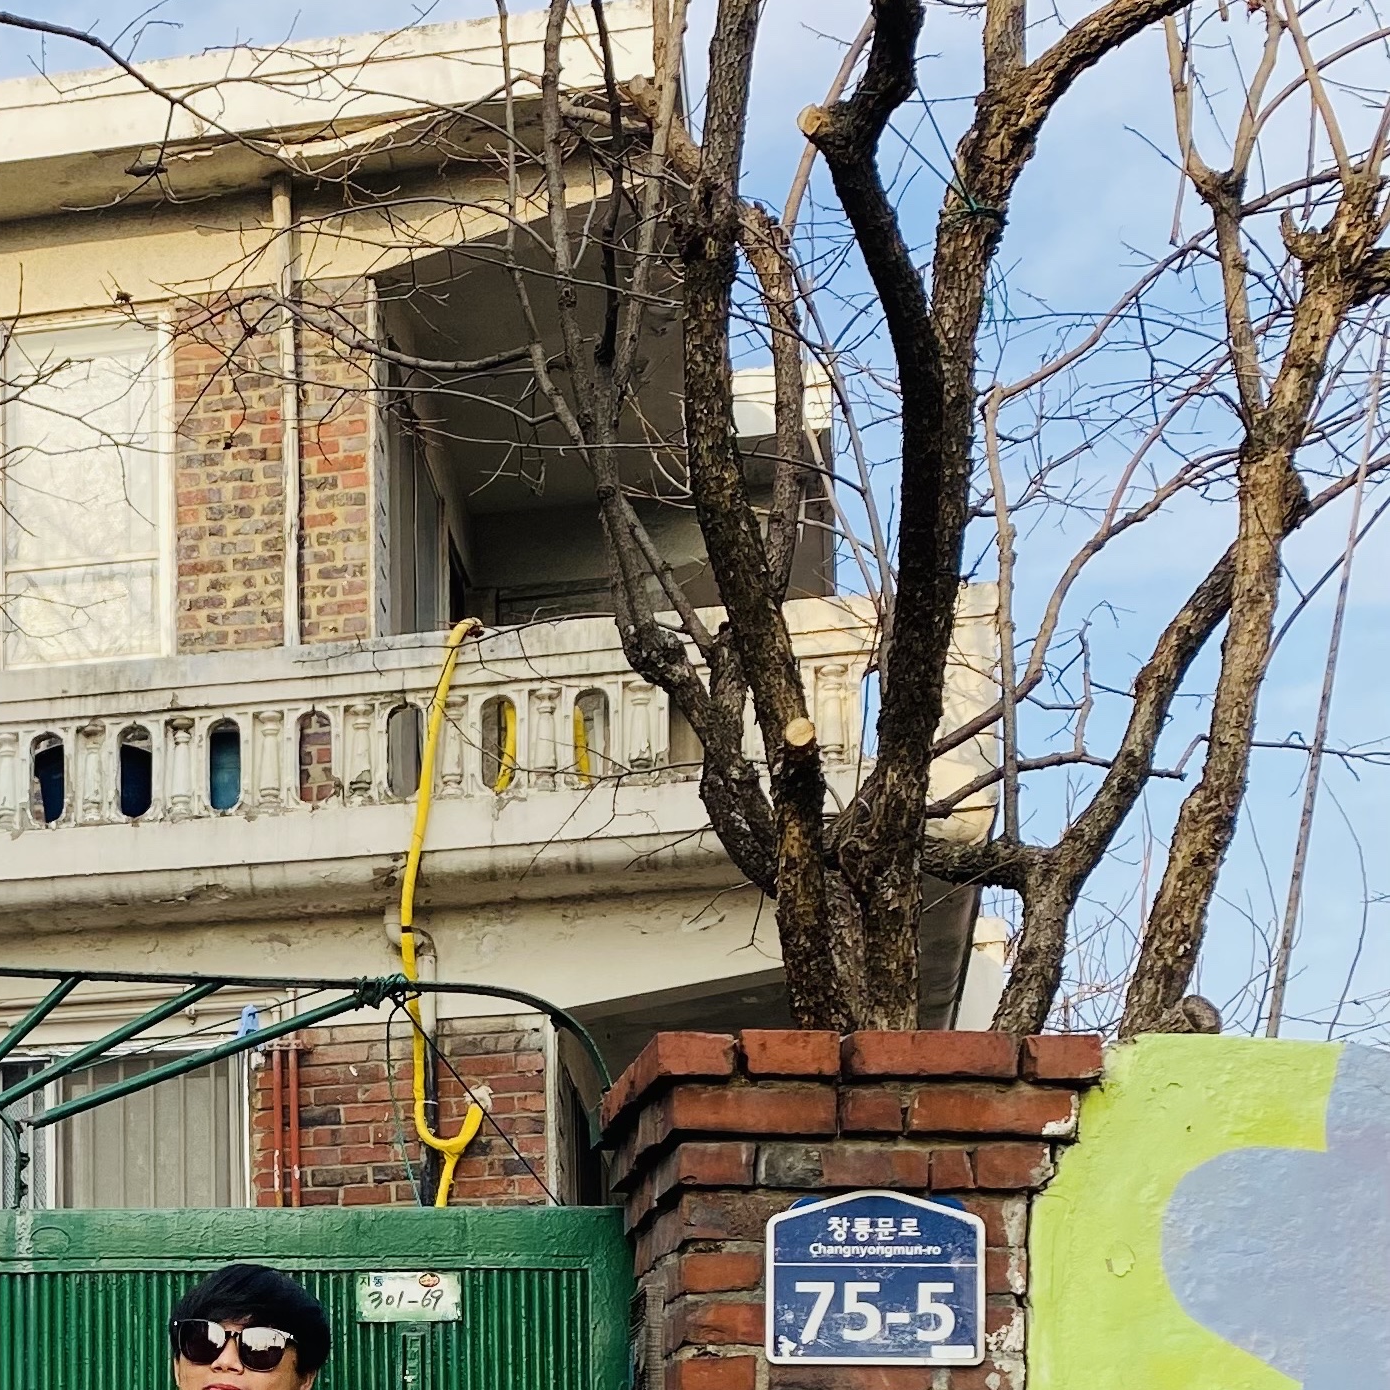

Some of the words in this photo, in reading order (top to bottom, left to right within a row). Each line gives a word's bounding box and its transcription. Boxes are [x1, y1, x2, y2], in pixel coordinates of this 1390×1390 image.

[826, 1216, 922, 1242] 창룡문로
[808, 1243, 942, 1257] Changnyongmun-ro
[359, 1275, 384, 1287] 지동
[368, 1288, 444, 1311] 301-69
[794, 1281, 956, 1344] 75-5
